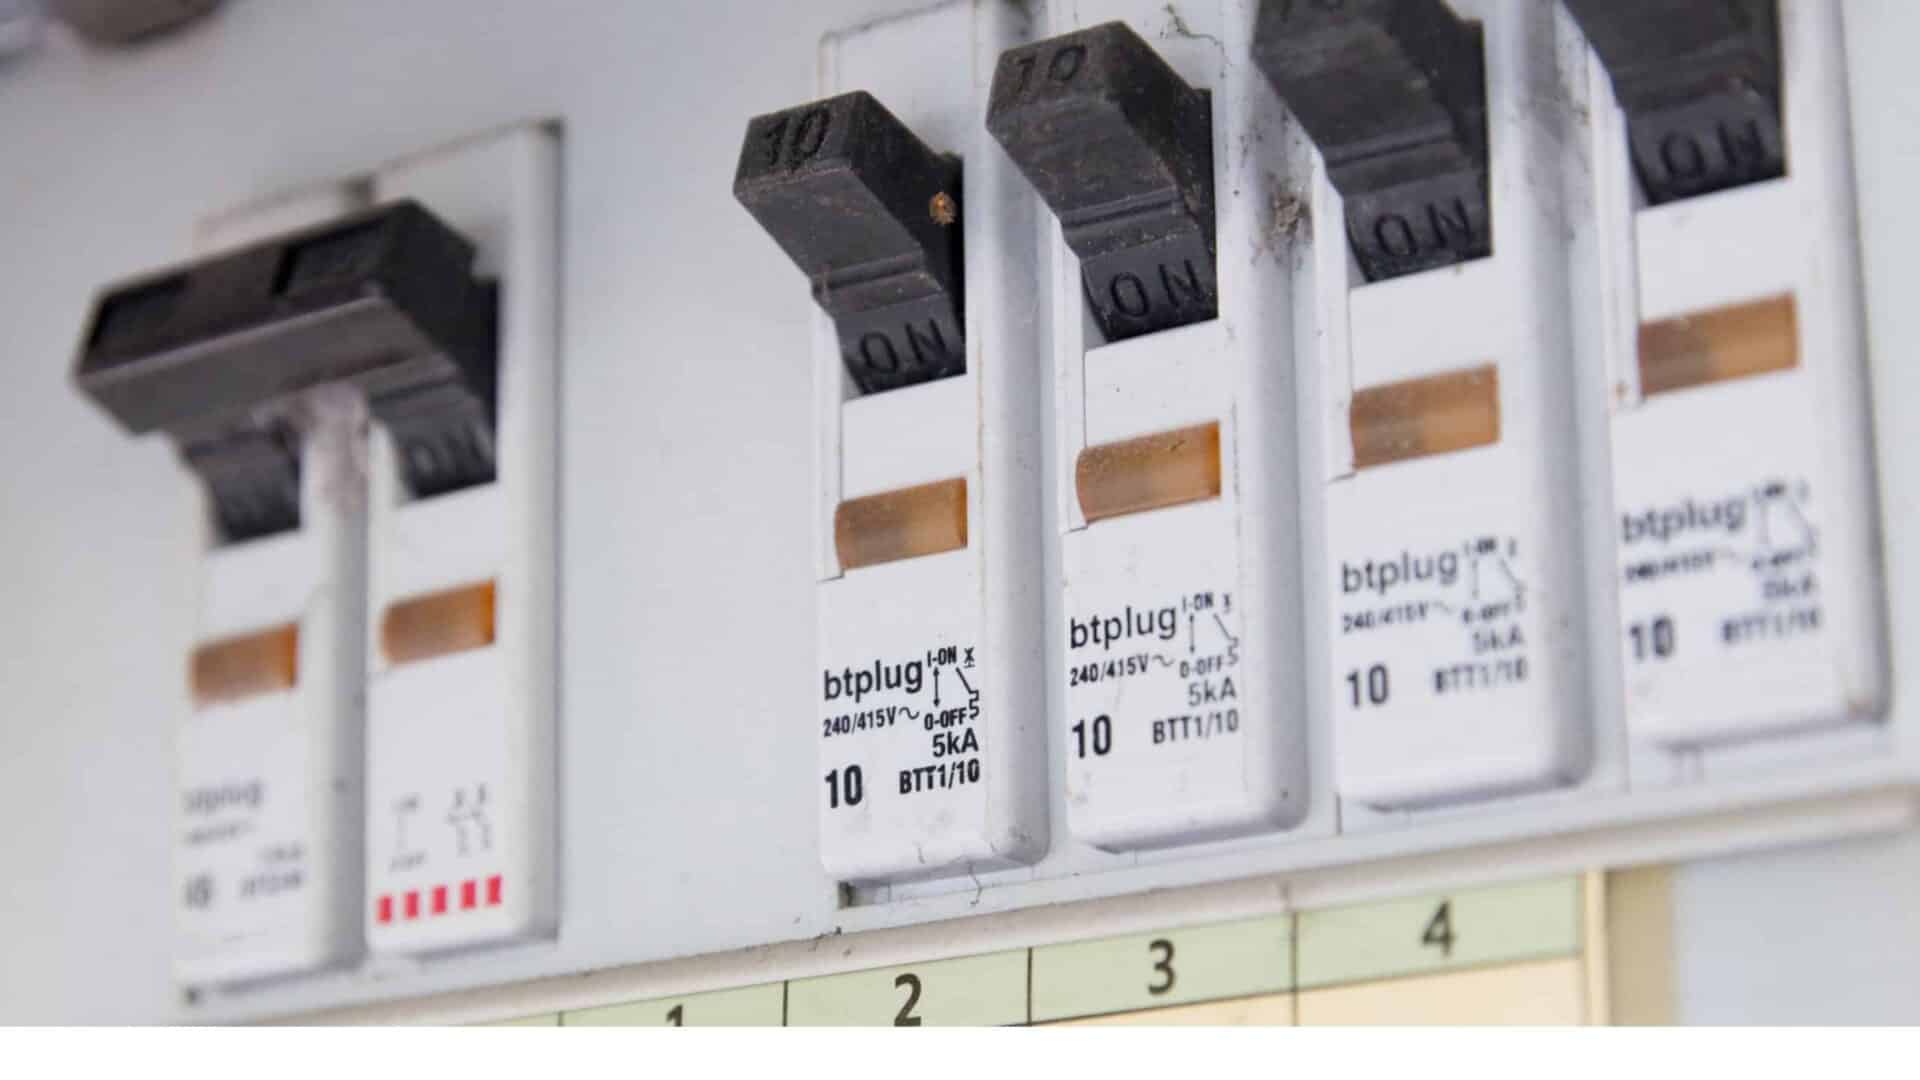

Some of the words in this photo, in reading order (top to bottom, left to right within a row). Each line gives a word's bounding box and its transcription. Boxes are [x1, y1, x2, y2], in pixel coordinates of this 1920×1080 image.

[1659, 118, 1766, 179] ON
[1373, 196, 1472, 258] ON
[1109, 259, 1207, 319] ON
[858, 316, 949, 376] ON
[1343, 549, 1458, 596] btplug
[1070, 605, 1177, 651] btplug
[1629, 614, 1676, 662] 10
[824, 659, 923, 704] btplug
[1188, 676, 1237, 707] 5kA
[1346, 663, 1390, 709] 10
[932, 727, 979, 758] 5kA
[1071, 713, 1112, 759] 10
[1152, 708, 1239, 745] BTT1/10
[824, 763, 863, 809] 10
[899, 757, 981, 795] BTT1/10
[1420, 895, 1455, 958] 4
[1146, 938, 1177, 996] 3
[893, 972, 923, 1026] 2
